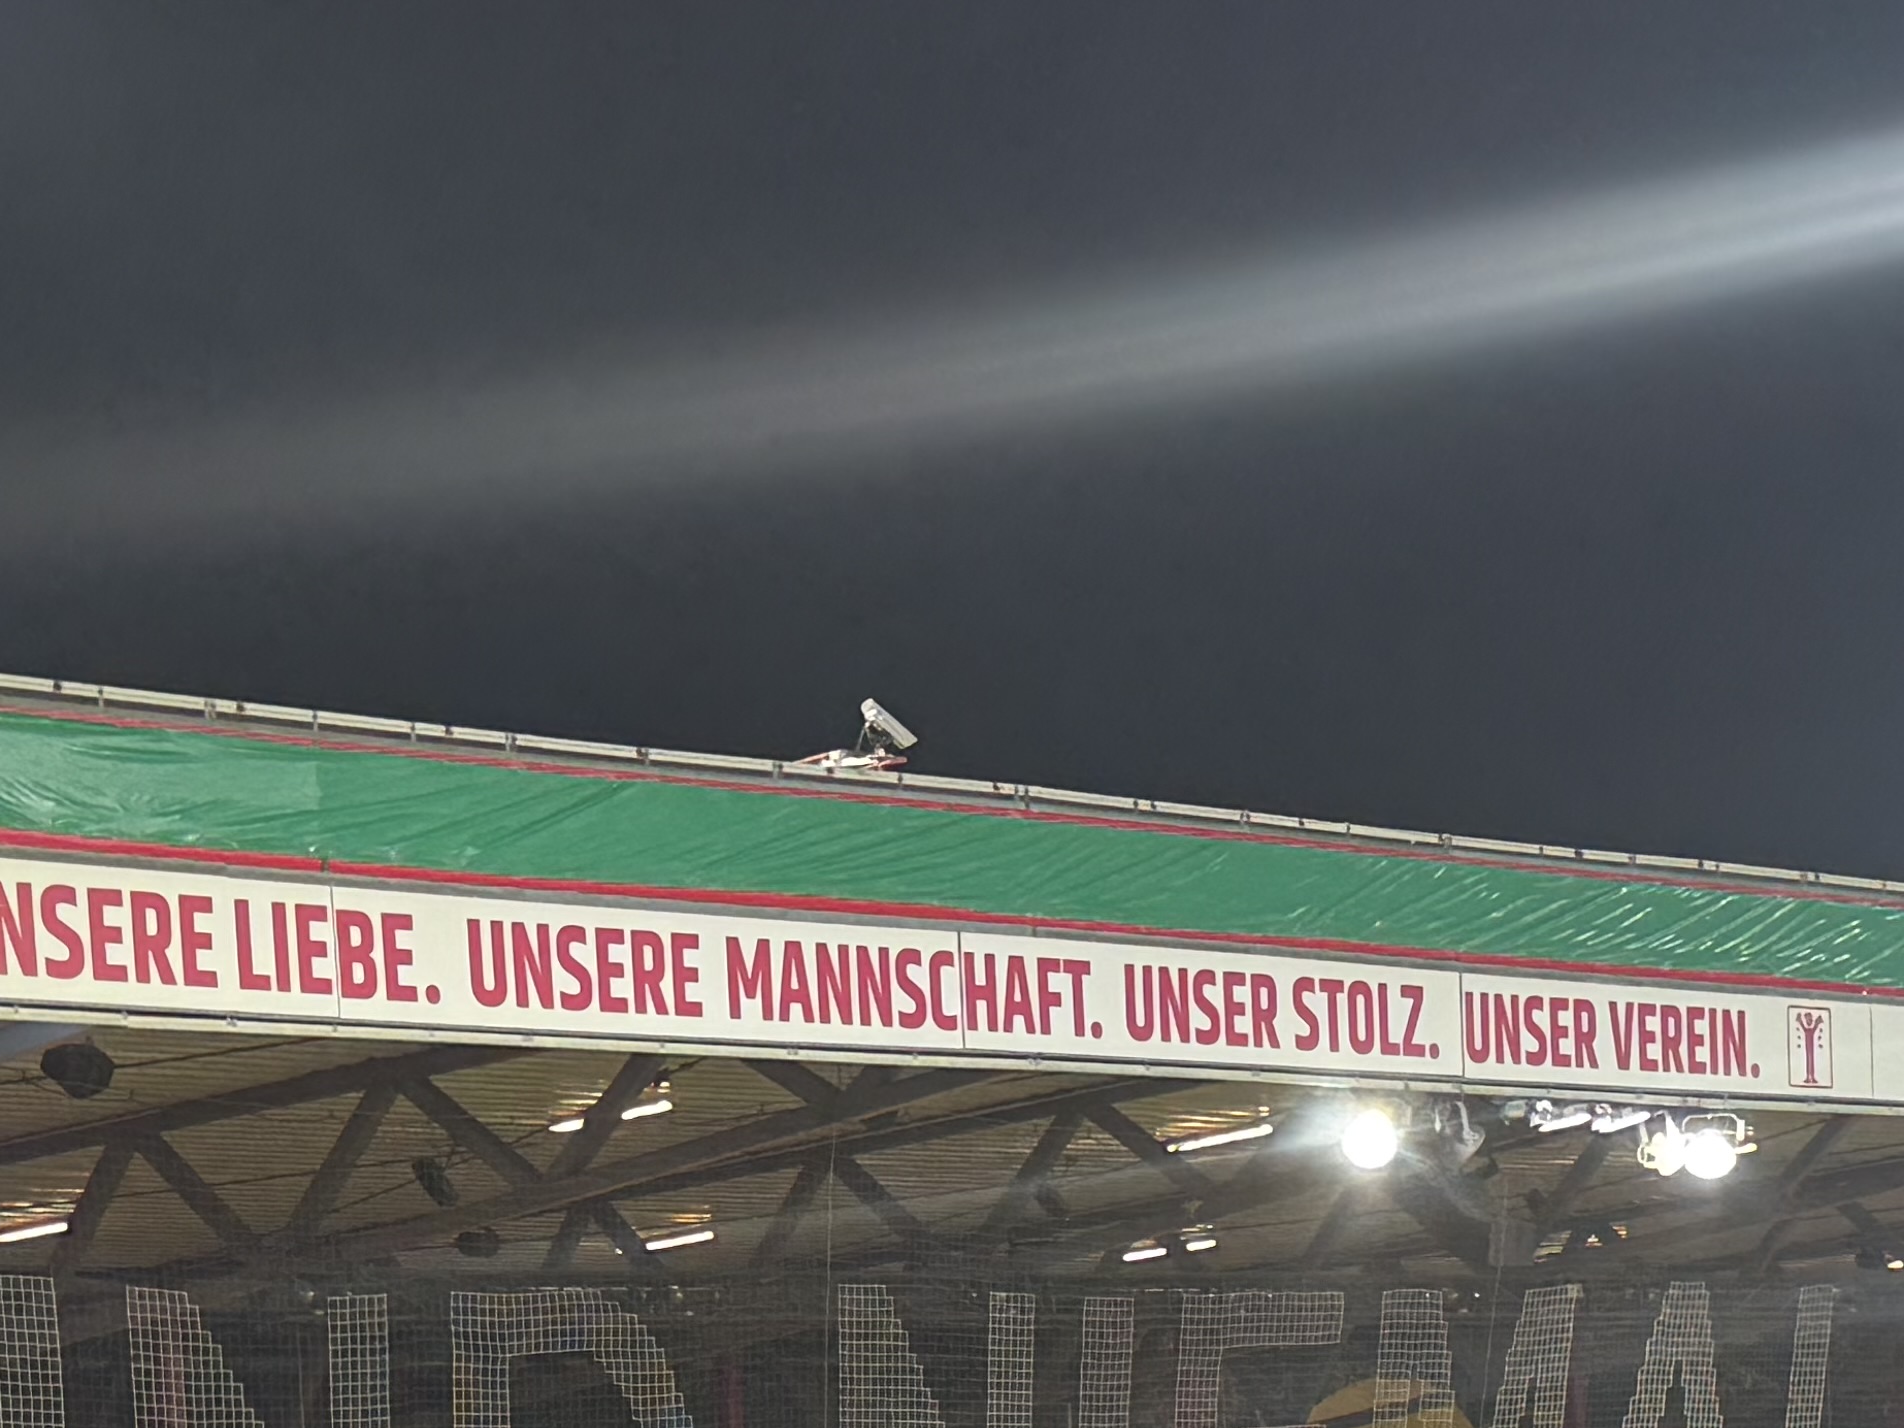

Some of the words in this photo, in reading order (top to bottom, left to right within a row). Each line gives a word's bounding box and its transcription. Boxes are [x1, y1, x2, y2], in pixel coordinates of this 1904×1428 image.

[235, 898, 440, 1004] LIEBE.
[468, 920, 701, 1018] UNSERE
[726, 935, 1102, 1039] MANNSCHAFT.
[1125, 962, 1278, 1049] UNSER
[1295, 976, 1439, 1060] STOLZ.
[1464, 988, 1598, 1070] UNSER
[1611, 1001, 1759, 1079] VEREIN.
